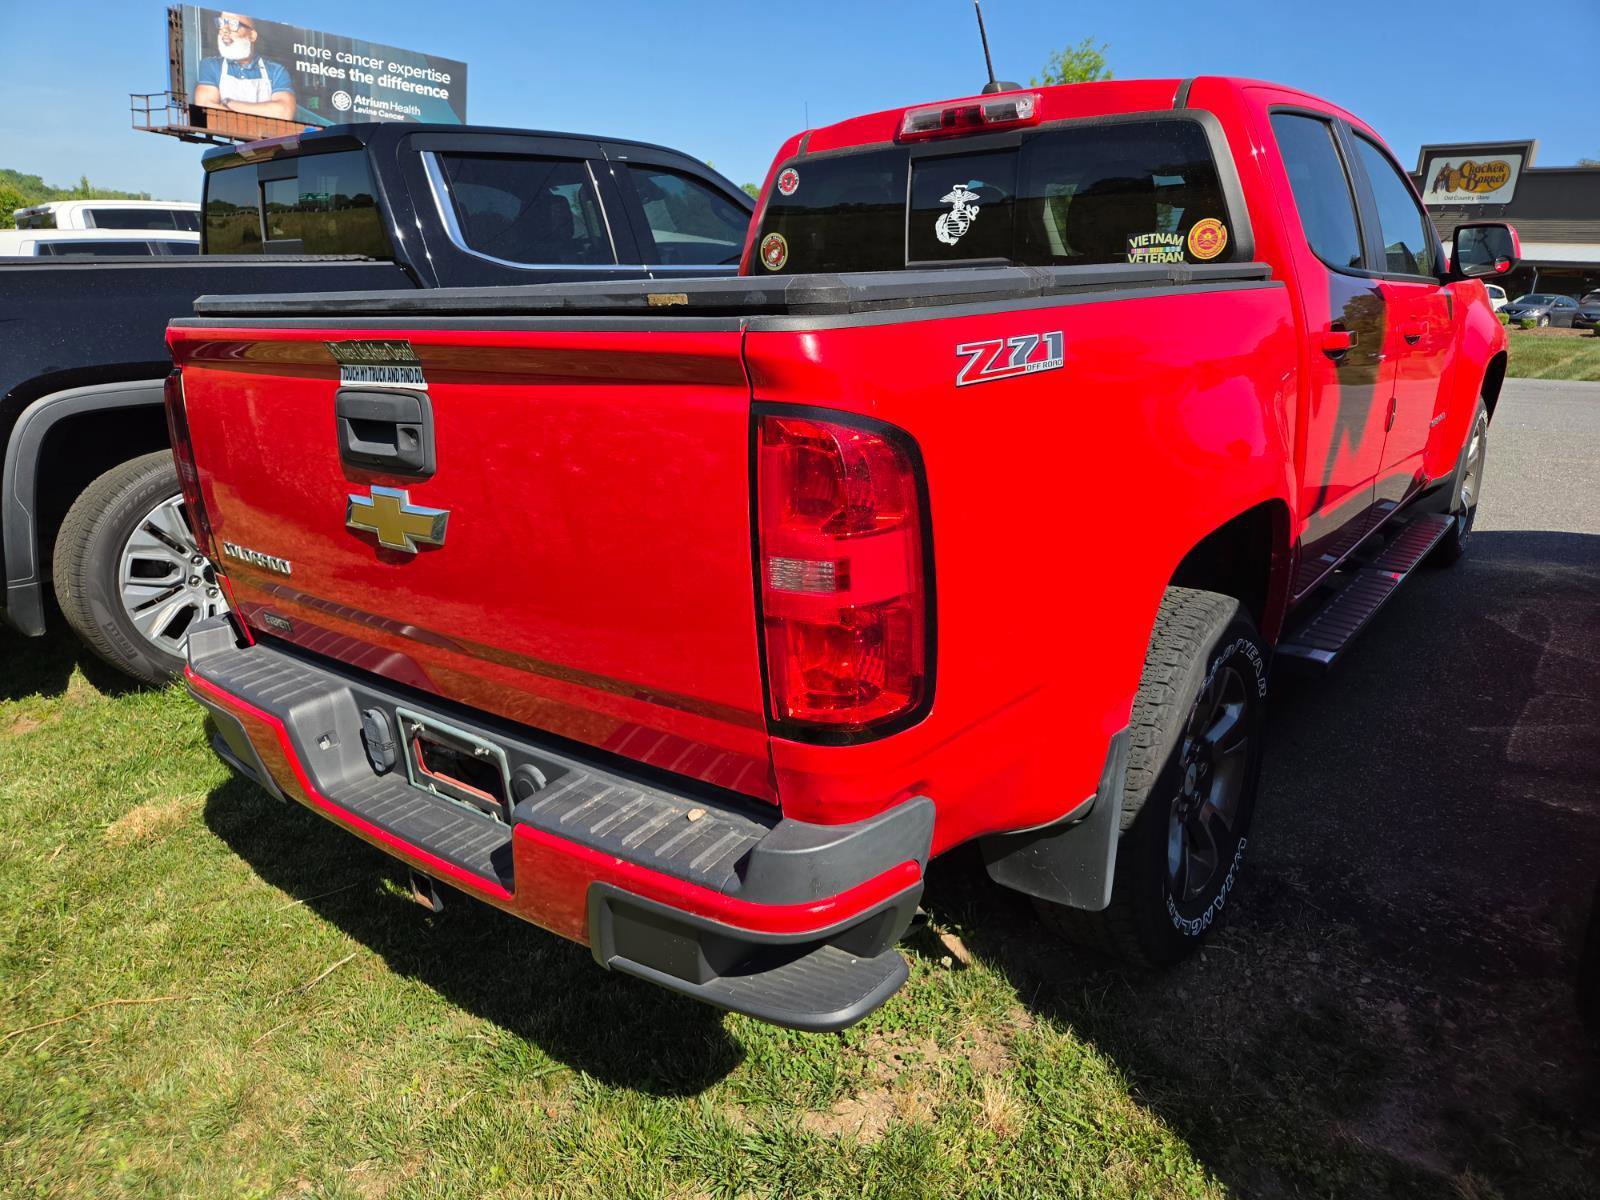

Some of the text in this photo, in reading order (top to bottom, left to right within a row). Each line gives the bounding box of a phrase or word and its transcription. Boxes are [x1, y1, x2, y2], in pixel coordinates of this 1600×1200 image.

[293, 43, 451, 84] more cancer expertise
[296, 60, 449, 99] makes the difference
[353, 94, 421, 116] Atrium Health
[353, 105, 405, 121] Levine Cancer
[1459, 160, 1505, 178] Cracker
[1465, 173, 1506, 191] Barrel
[1128, 233, 1185, 249] VIETNAM
[1127, 251, 1184, 264] VETERAN
[956, 330, 1064, 387] Z71
[1026, 359, 1063, 372] OFF ROAD
[342, 366, 360, 381] TOUCH
[359, 366, 368, 382] MY
[368, 367, 387, 383] TRUCK
[387, 367, 400, 383] AND
[399, 367, 415, 383] FIND
